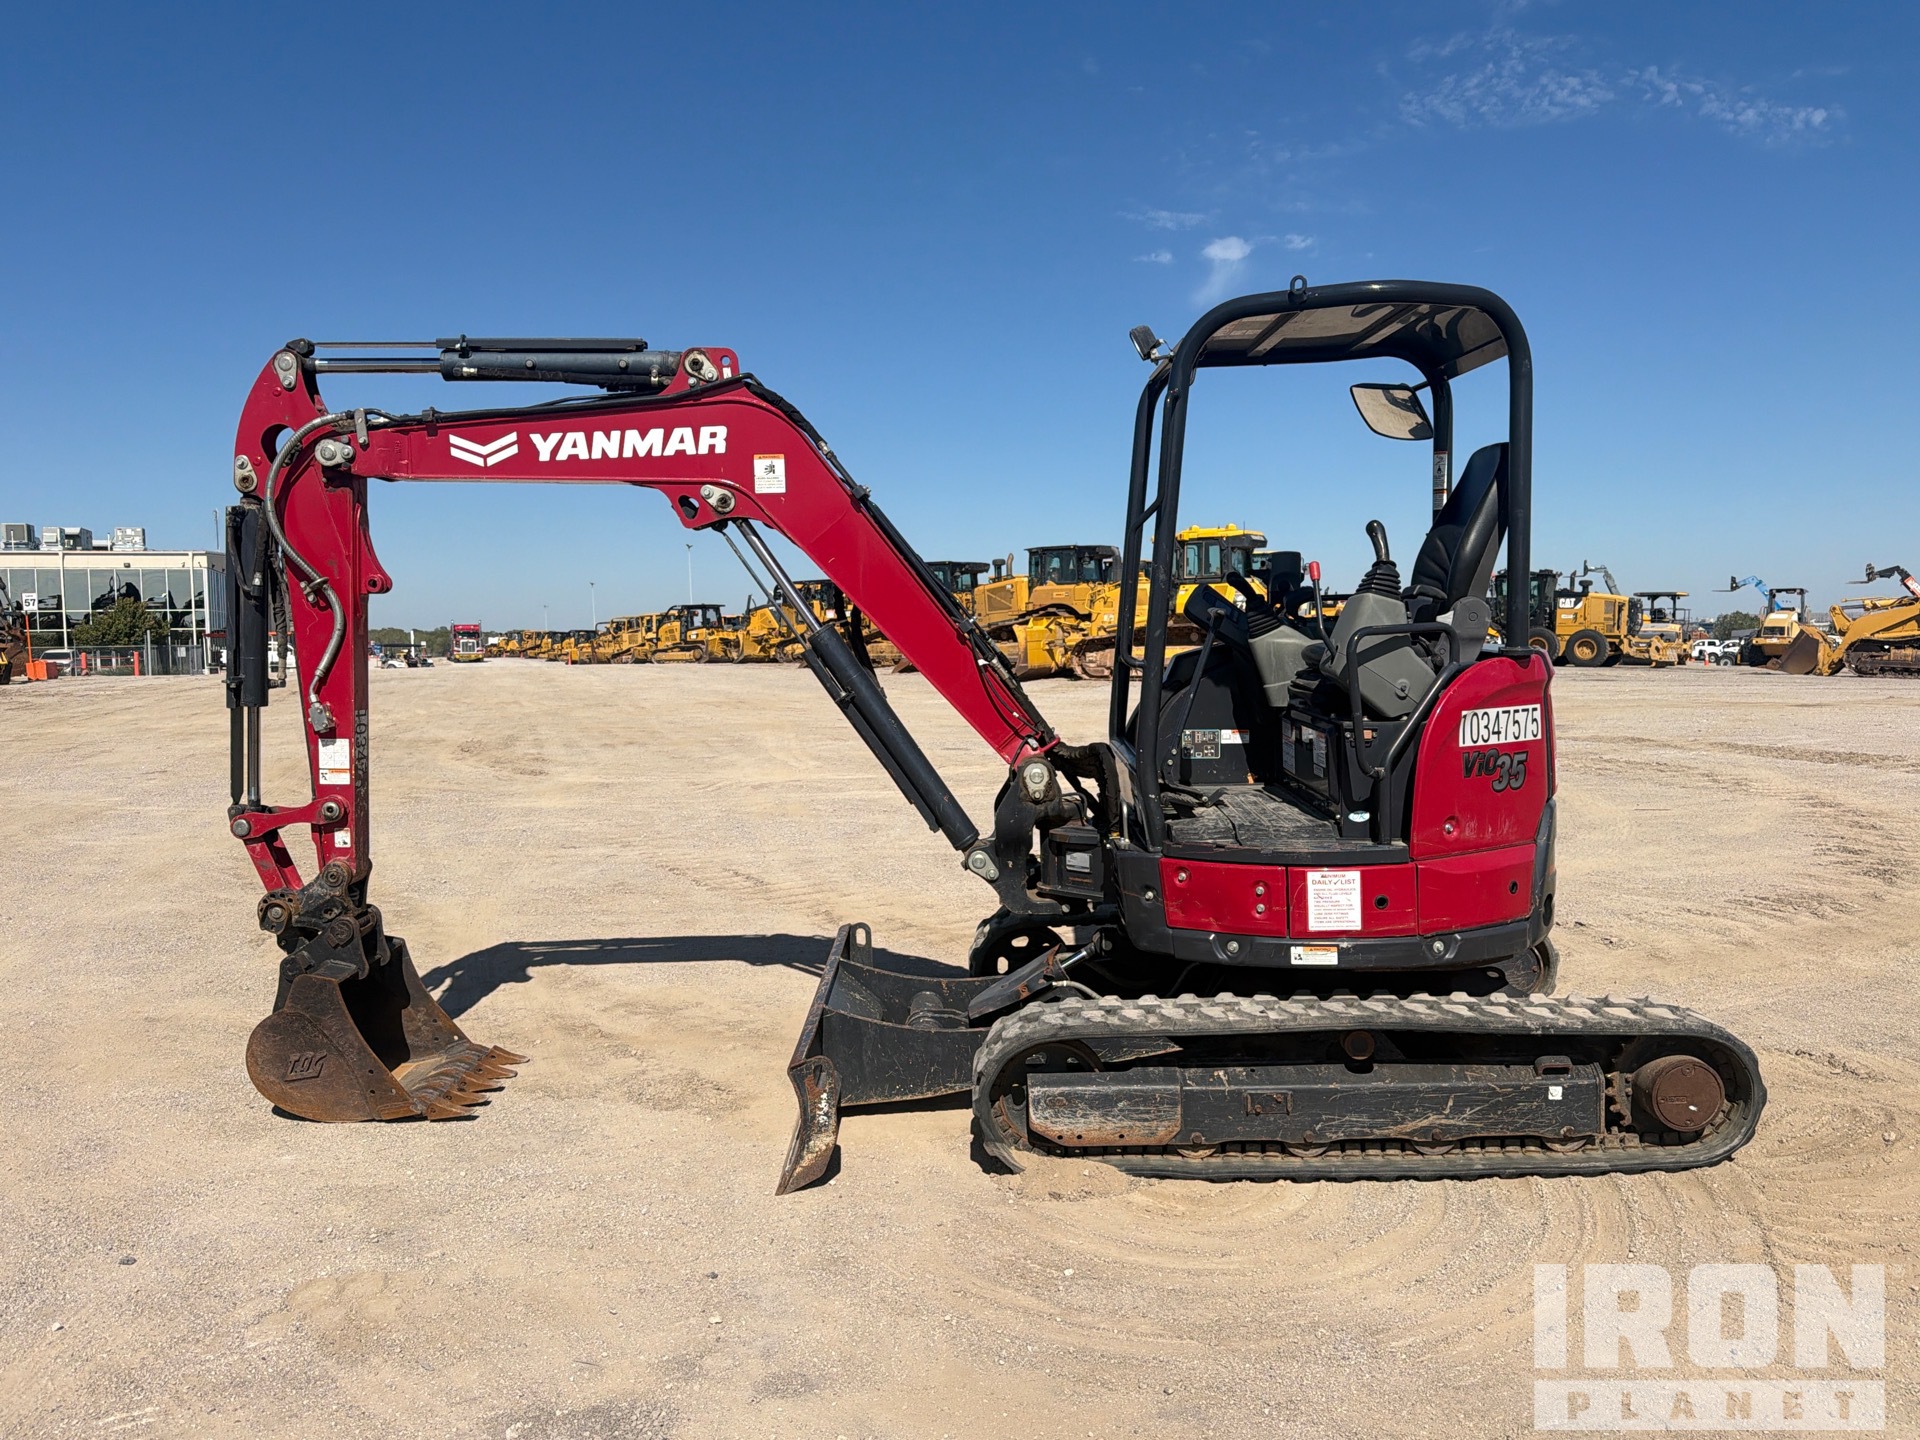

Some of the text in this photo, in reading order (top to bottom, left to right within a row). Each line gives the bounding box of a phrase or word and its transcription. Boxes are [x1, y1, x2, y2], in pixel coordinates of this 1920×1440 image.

[529, 425, 727, 462] YANMAR
[24, 598, 36, 607] 57
[1559, 597, 1576, 608] CAT
[1462, 707, 1539, 745] 10347575
